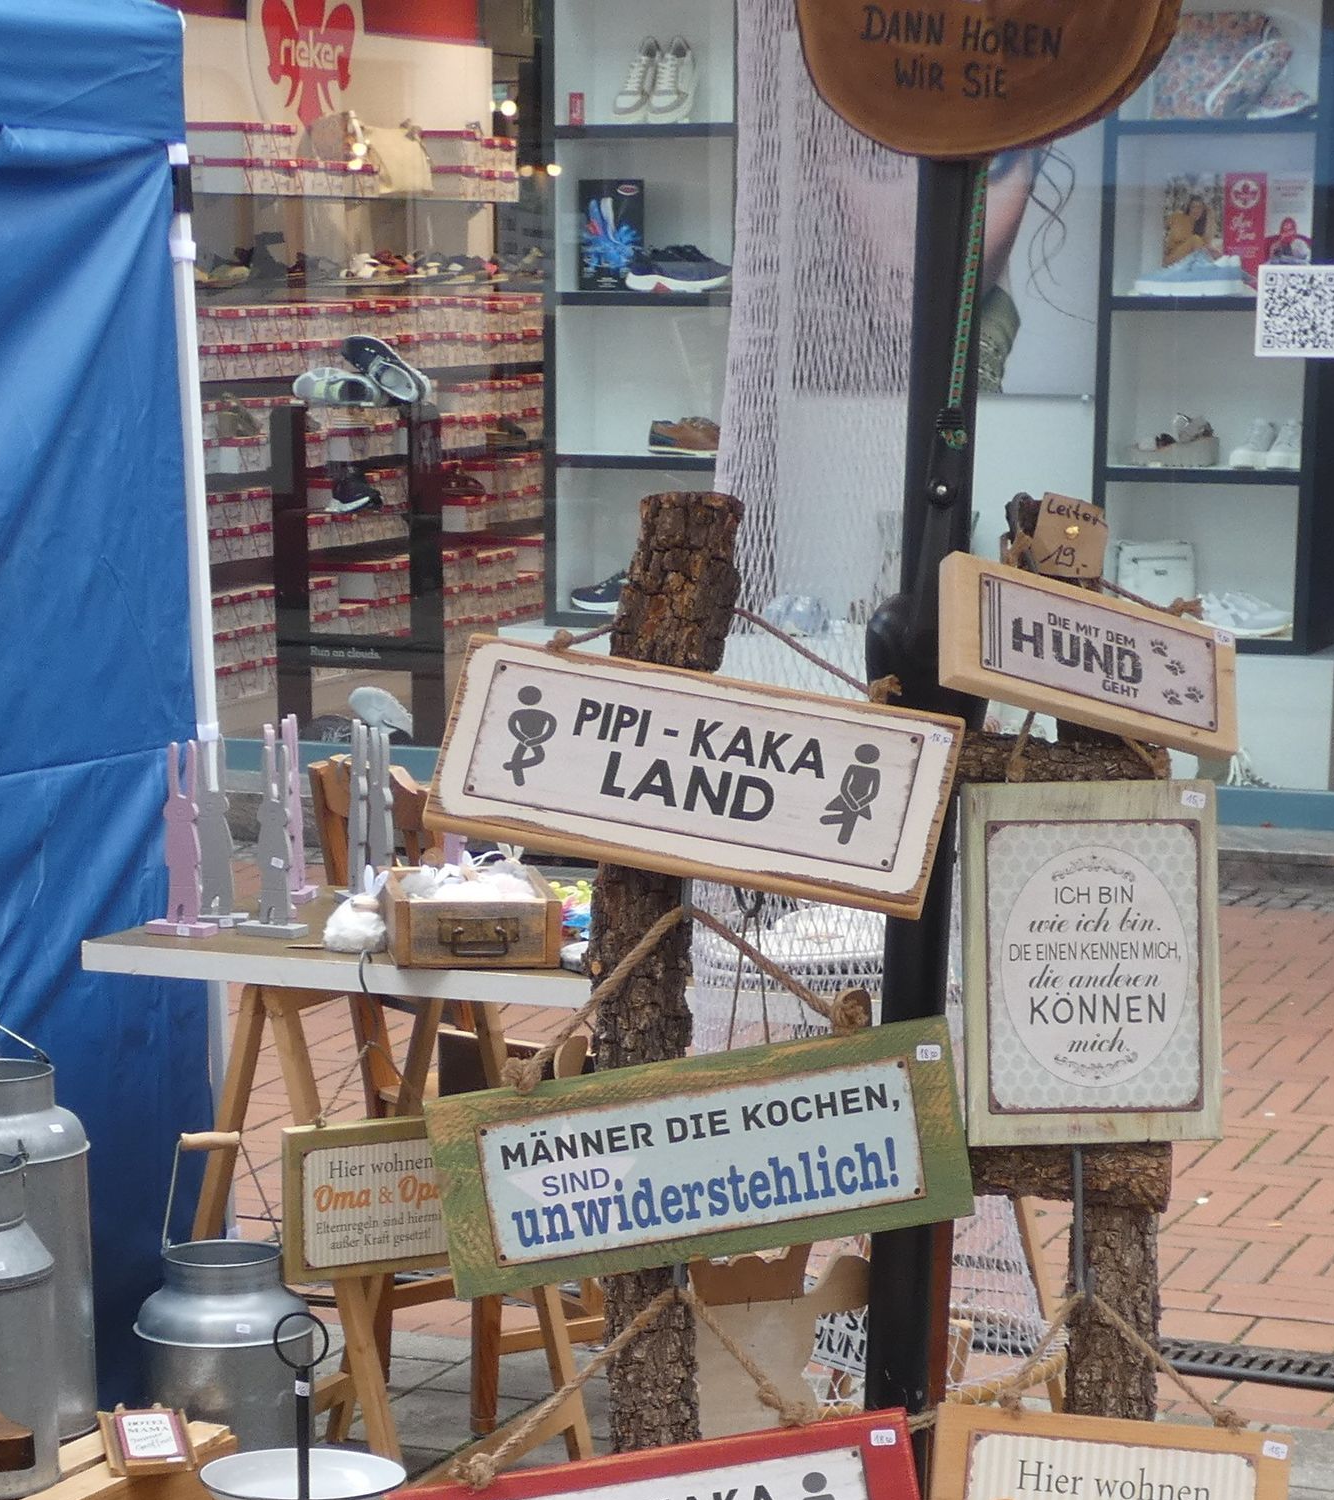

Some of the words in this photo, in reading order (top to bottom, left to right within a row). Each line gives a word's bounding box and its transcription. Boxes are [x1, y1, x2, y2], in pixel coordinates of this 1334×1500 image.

[860, 4, 946, 46] DANN
[279, 29, 345, 71] rieker
[1046, 498, 1108, 527] Leiter
[1047, 612, 1070, 631] DIE
[1075, 620, 1101, 638] MIT
[1106, 630, 1136, 649] DEM
[310, 646, 330, 657] Run
[332, 649, 345, 657] on
[347, 647, 381, 659] clouds.
[1011, 616, 1145, 685] HUND
[1101, 678, 1140, 699] GEHT
[572, 698, 654, 748] PIPI
[688, 718, 826, 780] KAKA
[599, 750, 775, 823] LAND
[1054, 886, 1092, 905] ICH
[1098, 885, 1134, 905] BIN
[1027, 914, 1069, 934] wie
[1076, 908, 1111, 933] ich
[1117, 907, 1162, 933] bin.
[1009, 943, 1032, 962] DIE
[1036, 943, 1078, 961] EINEN
[1081, 941, 1139, 960] KENNEN
[1142, 941, 1182, 963] MICH,
[1028, 964, 1064, 989] die
[1068, 963, 1161, 989] anderen
[1029, 991, 1166, 1025] KÖNNEN
[1067, 1028, 1130, 1054] mich.
[500, 1121, 654, 1171] MÄNNER
[666, 1110, 731, 1145] DIE
[740, 1082, 901, 1133] KOCHEN,
[329, 1160, 366, 1179] Hier
[371, 1153, 434, 1175] wohnen
[512, 1136, 901, 1250] unwiderstehlich!
[541, 1166, 611, 1198] SIND
[313, 1184, 371, 1213] Oma
[378, 1186, 394, 1204] &
[316, 1214, 379, 1235] Elternregeln
[383, 1211, 404, 1226] sind
[330, 1234, 360, 1250] außer
[364, 1231, 390, 1246] Kraft
[393, 1227, 432, 1247] gesetzt!
[1017, 1459, 1083, 1495] Hier
